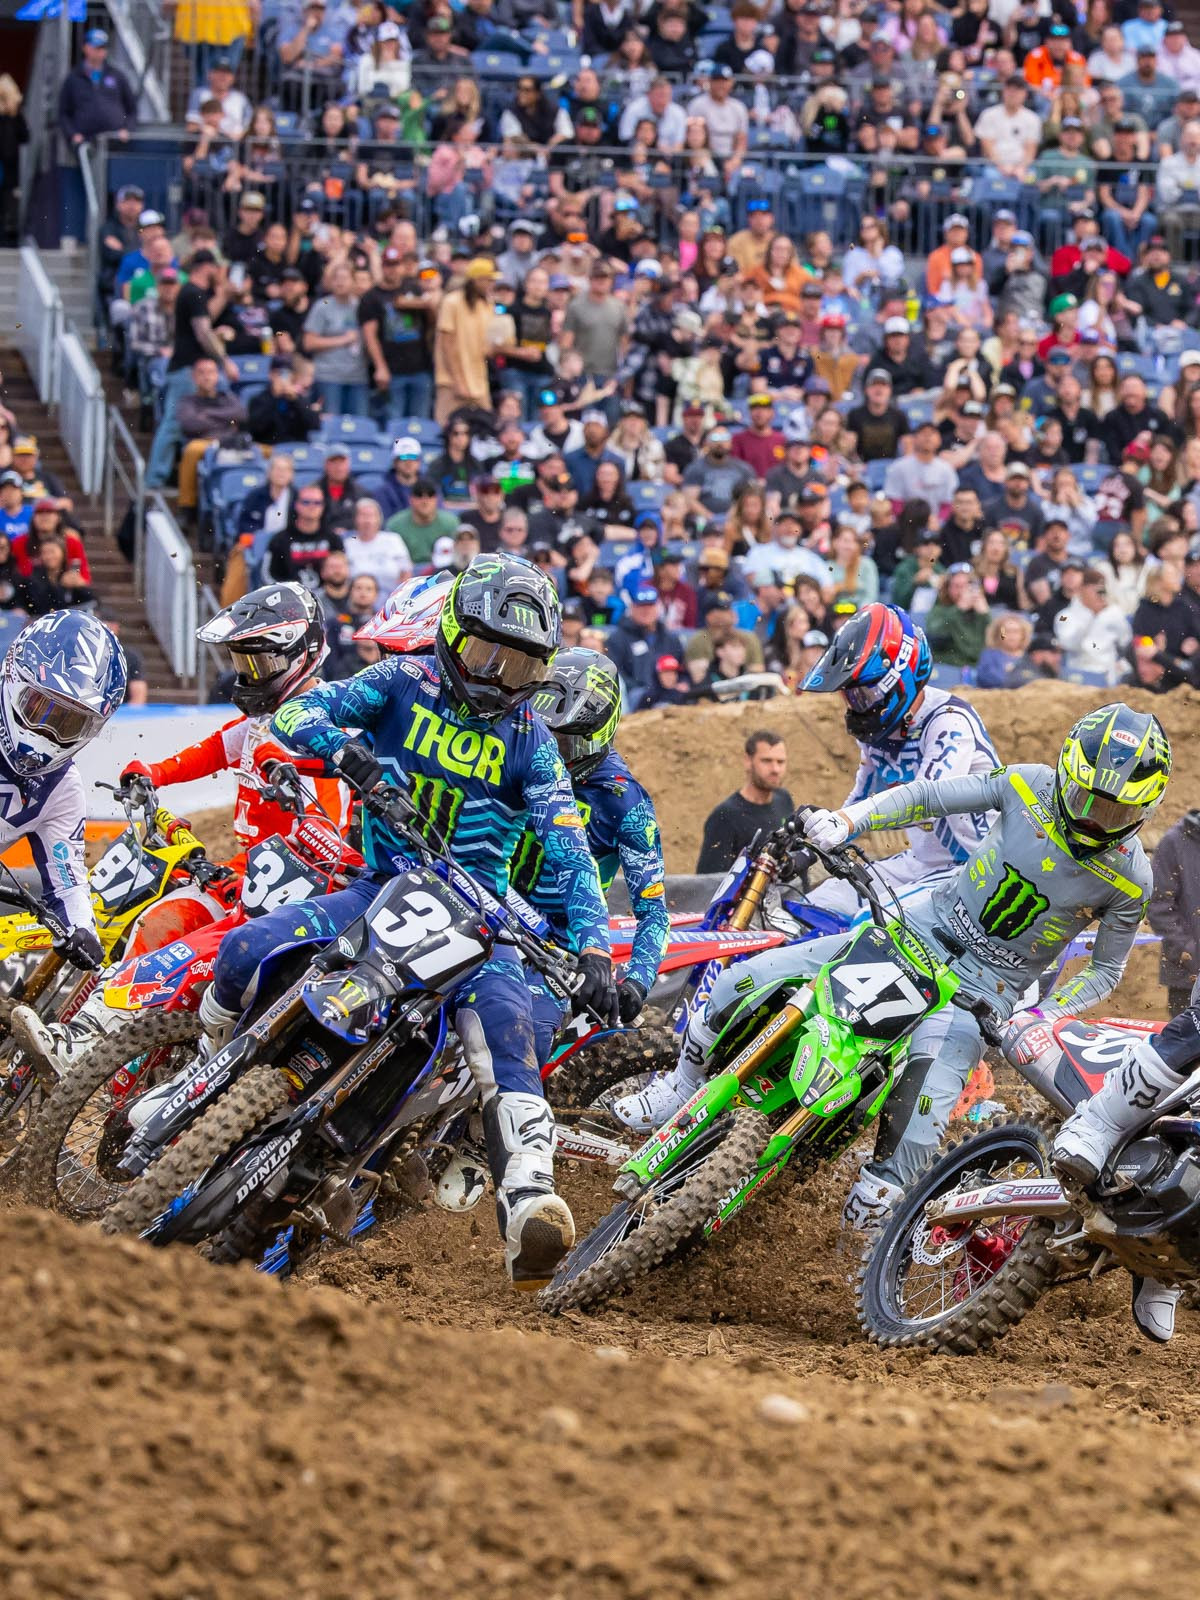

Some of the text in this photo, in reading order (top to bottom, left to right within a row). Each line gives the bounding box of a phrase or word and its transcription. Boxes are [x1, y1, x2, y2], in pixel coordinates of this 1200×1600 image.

[403, 702, 506, 786] THOR
[1115, 731, 1137, 746] BELL
[90, 842, 155, 902] 87
[240, 849, 315, 908] 34
[1083, 858, 1117, 882] Kawasaki
[46, 917, 66, 939] ARC
[370, 890, 485, 981] 31
[953, 897, 1028, 969] Kawasaki
[718, 938, 770, 950] DUNLOP
[546, 975, 567, 999] ARC
[831, 961, 928, 1026] 47
[762, 1013, 788, 1041] PRO
[1103, 1017, 1155, 1029] HONDA
[562, 1139, 611, 1159] ENTHAL
[648, 1104, 709, 1174] DUNLOP
[235, 1128, 302, 1204] DUNLOP
[955, 1193, 980, 1208] DID
